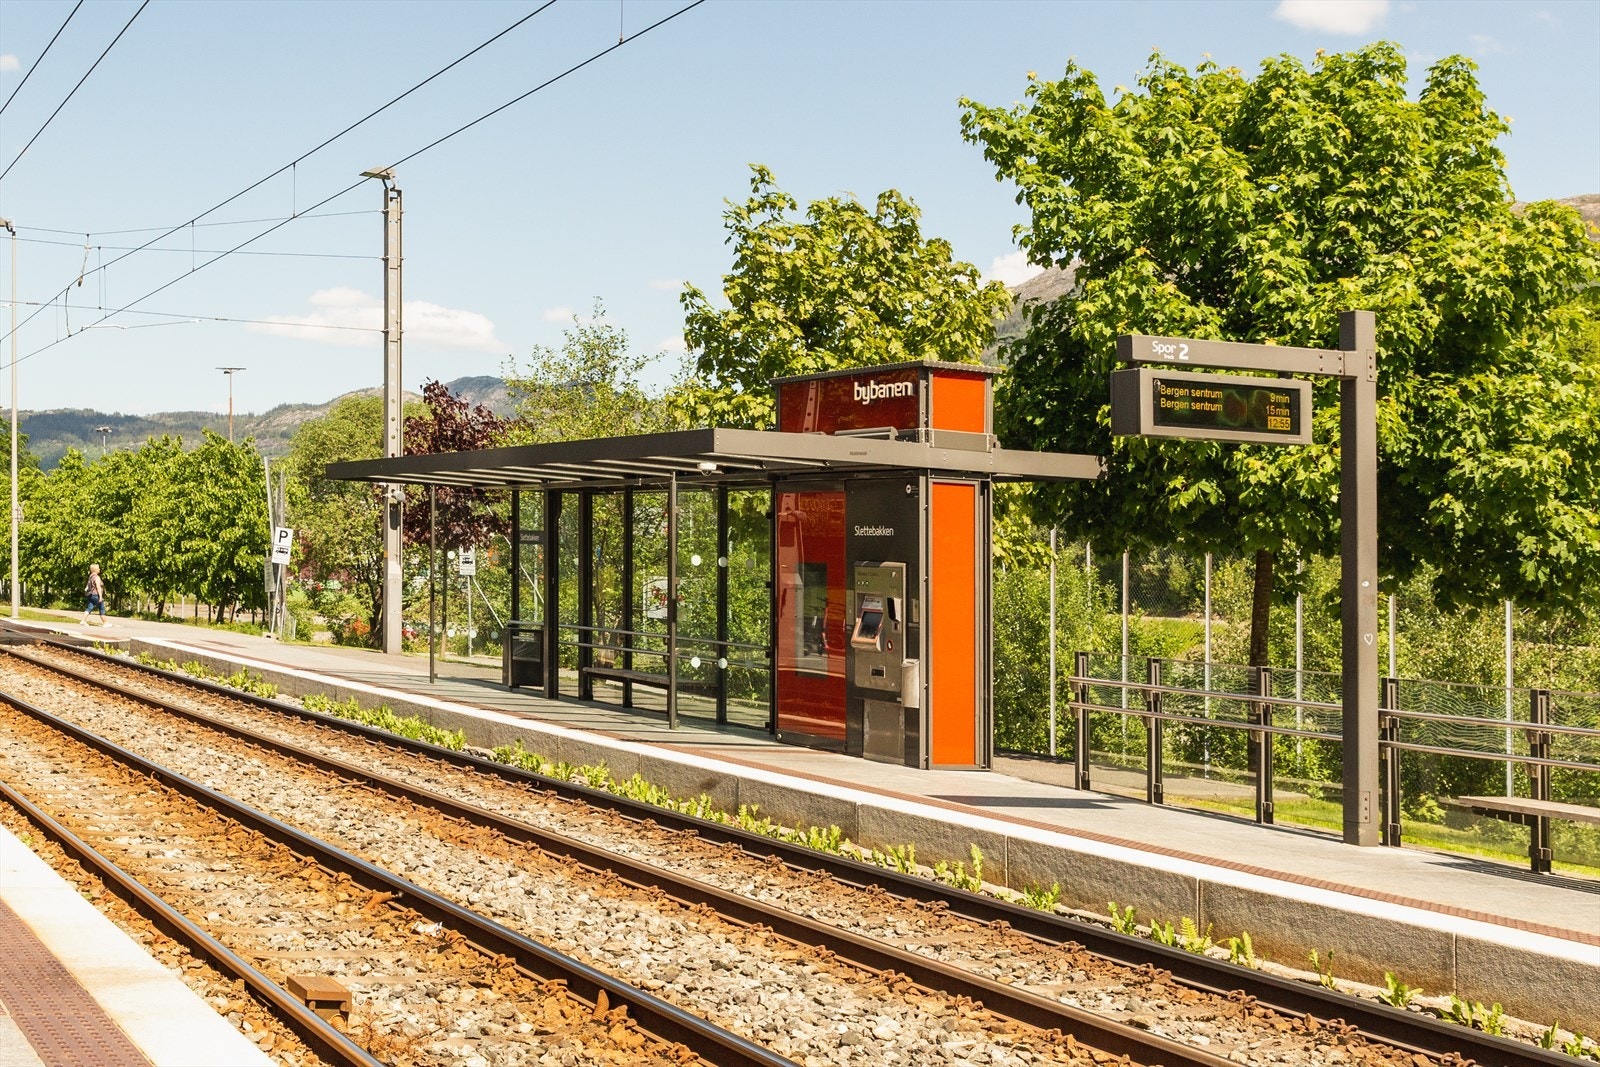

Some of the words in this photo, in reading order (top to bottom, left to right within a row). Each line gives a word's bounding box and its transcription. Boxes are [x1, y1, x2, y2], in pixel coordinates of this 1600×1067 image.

[1152, 340, 1176, 355] Spor
[1179, 343, 1189, 360] 2
[853, 380, 913, 404] bybanen
[1160, 384, 1189, 398] Bergen
[1191, 388, 1223, 399] sentrum
[1160, 397, 1189, 411] Bergen
[1191, 401, 1223, 412] sentrum
[1268, 417, 1290, 429] 12:55
[279, 530, 288, 543] P
[854, 525, 894, 537] Slettebakken
